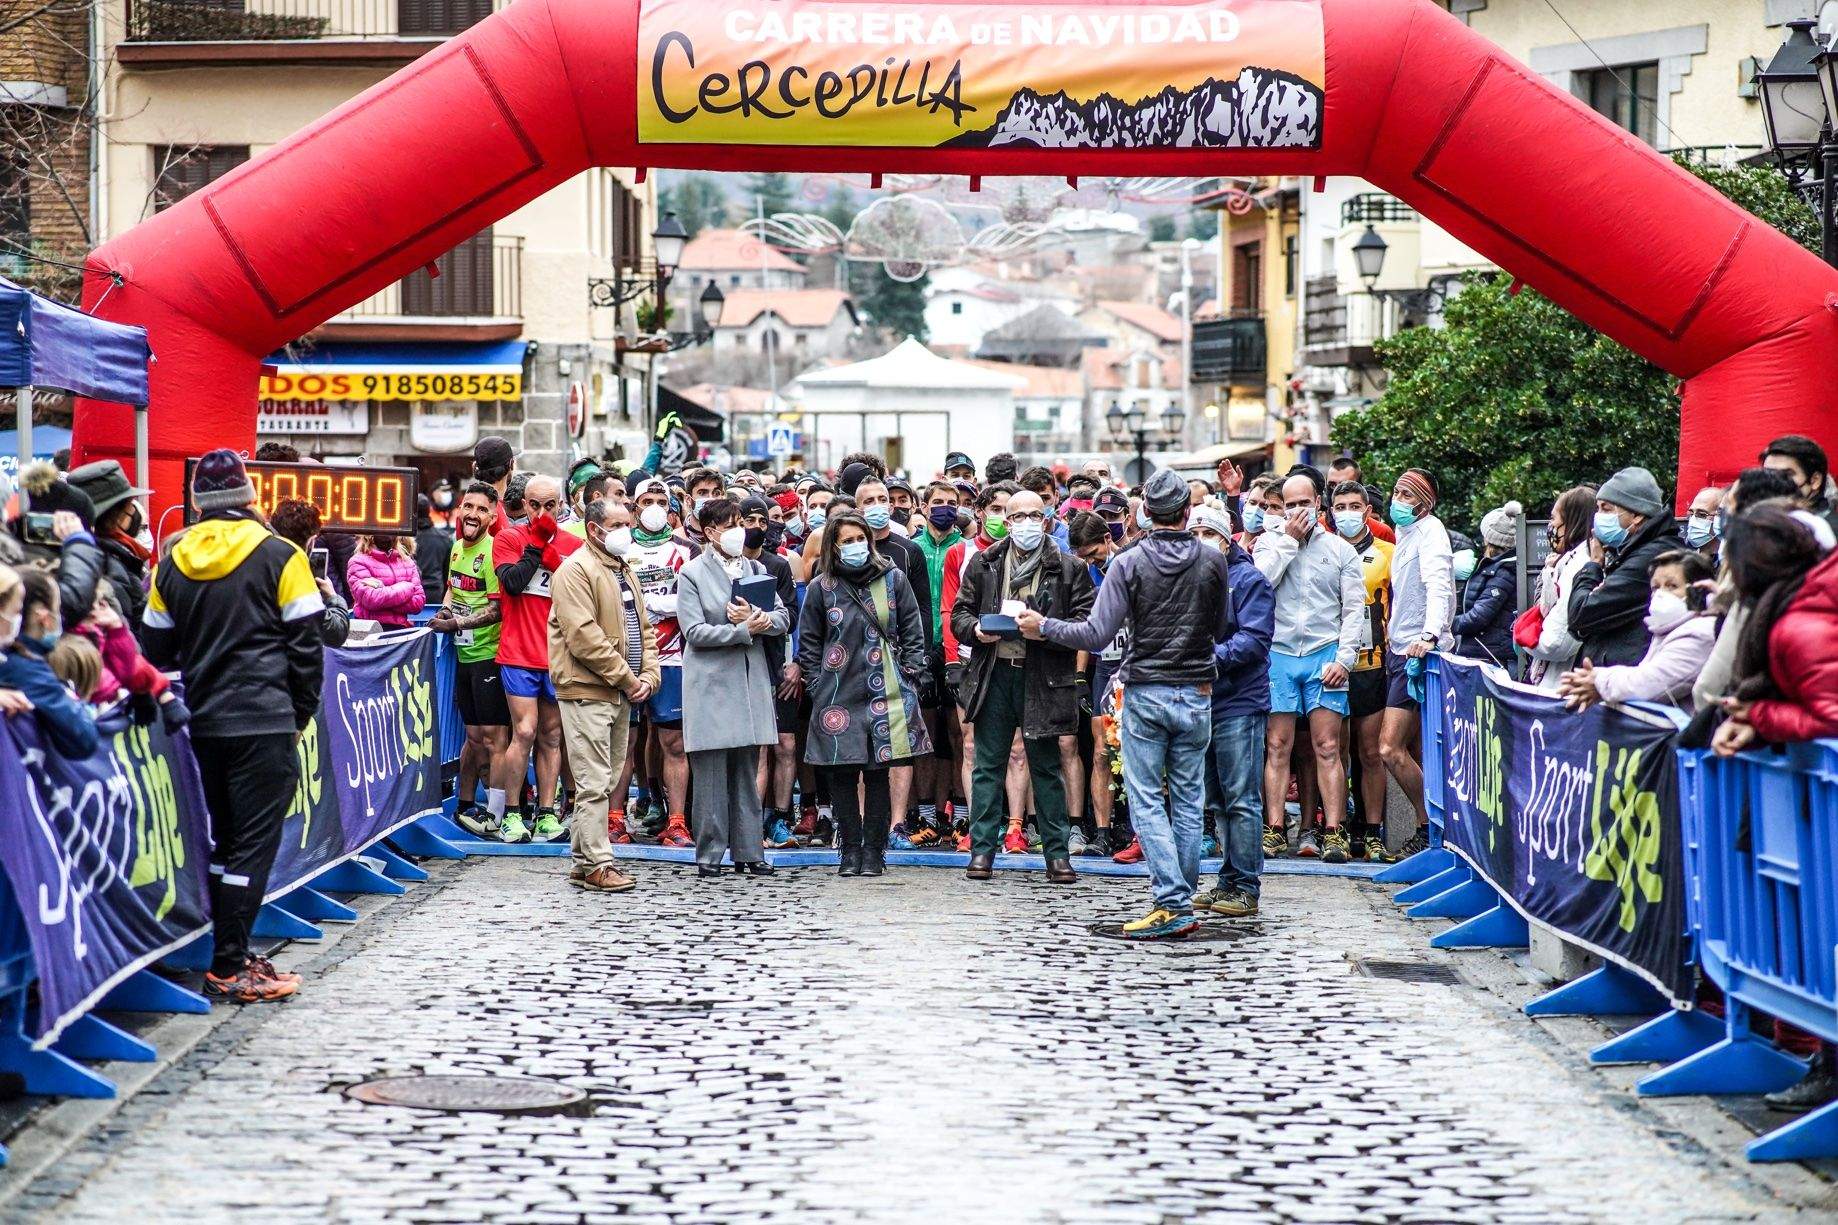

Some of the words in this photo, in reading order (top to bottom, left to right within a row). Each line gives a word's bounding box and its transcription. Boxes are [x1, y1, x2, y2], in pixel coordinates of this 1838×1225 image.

[724, 9, 960, 45] CARRERA
[970, 22, 1011, 46] DE
[1020, 9, 1241, 46] NAVIDAD
[258, 374, 352, 395] DOS
[363, 375, 516, 395] 918508545
